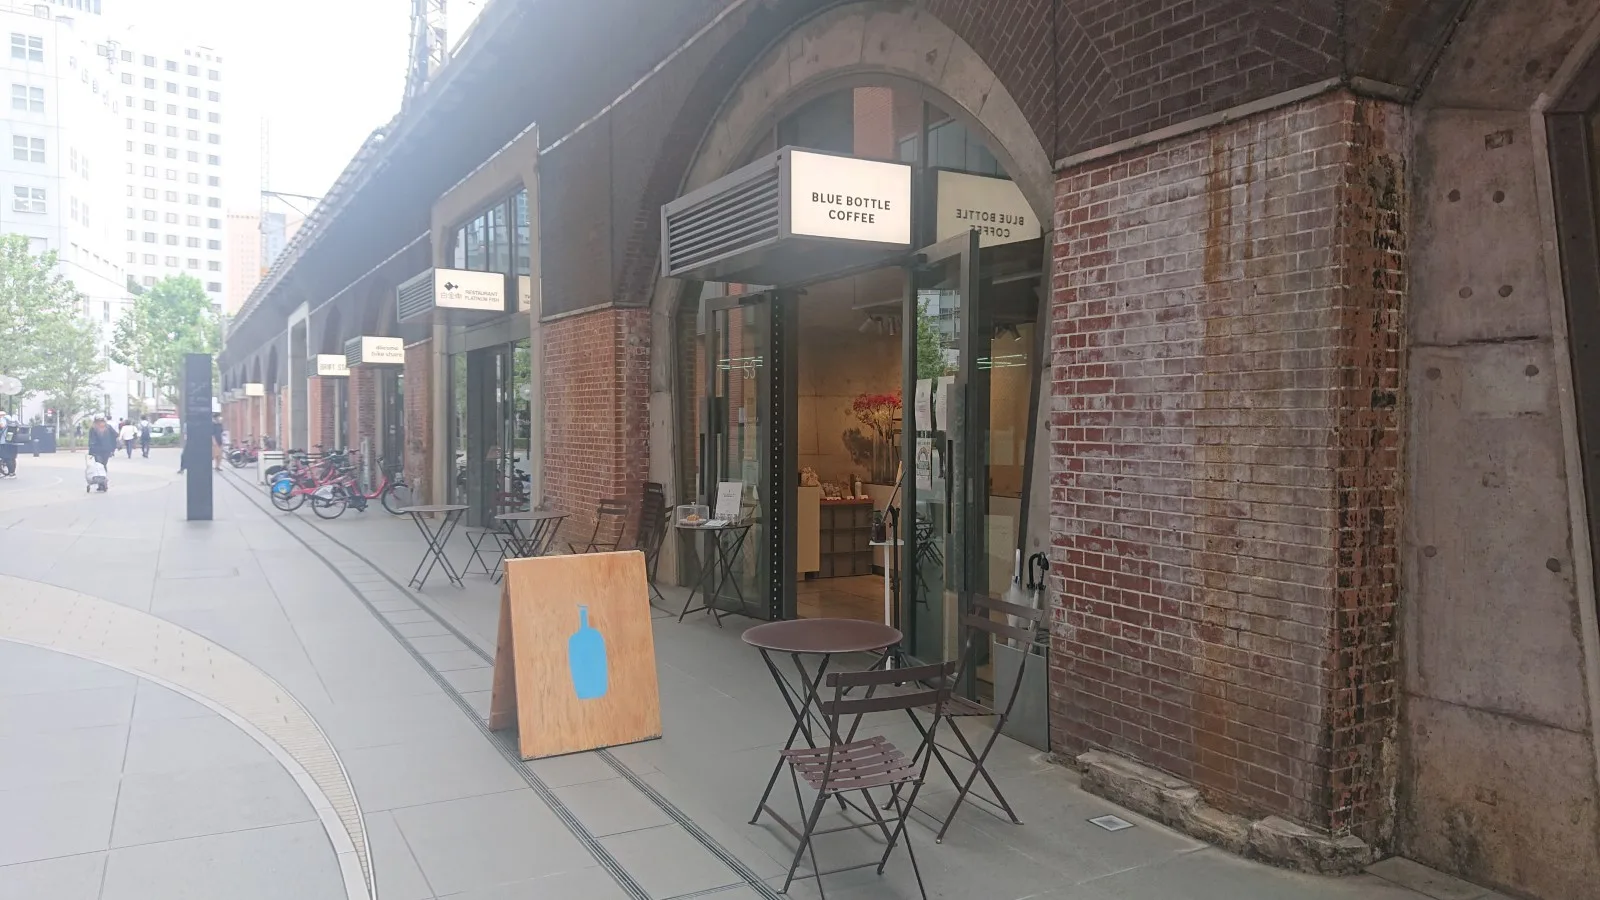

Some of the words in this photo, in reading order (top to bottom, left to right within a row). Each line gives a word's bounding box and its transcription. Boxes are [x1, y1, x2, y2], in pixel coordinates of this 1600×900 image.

[812, 191, 842, 205] BLUE
[846, 195, 891, 211] BOTTLE
[828, 209, 875, 224] COFFEE
[465, 289, 498, 297] RESTAURANT
[743, 361, 756, 380] S3
